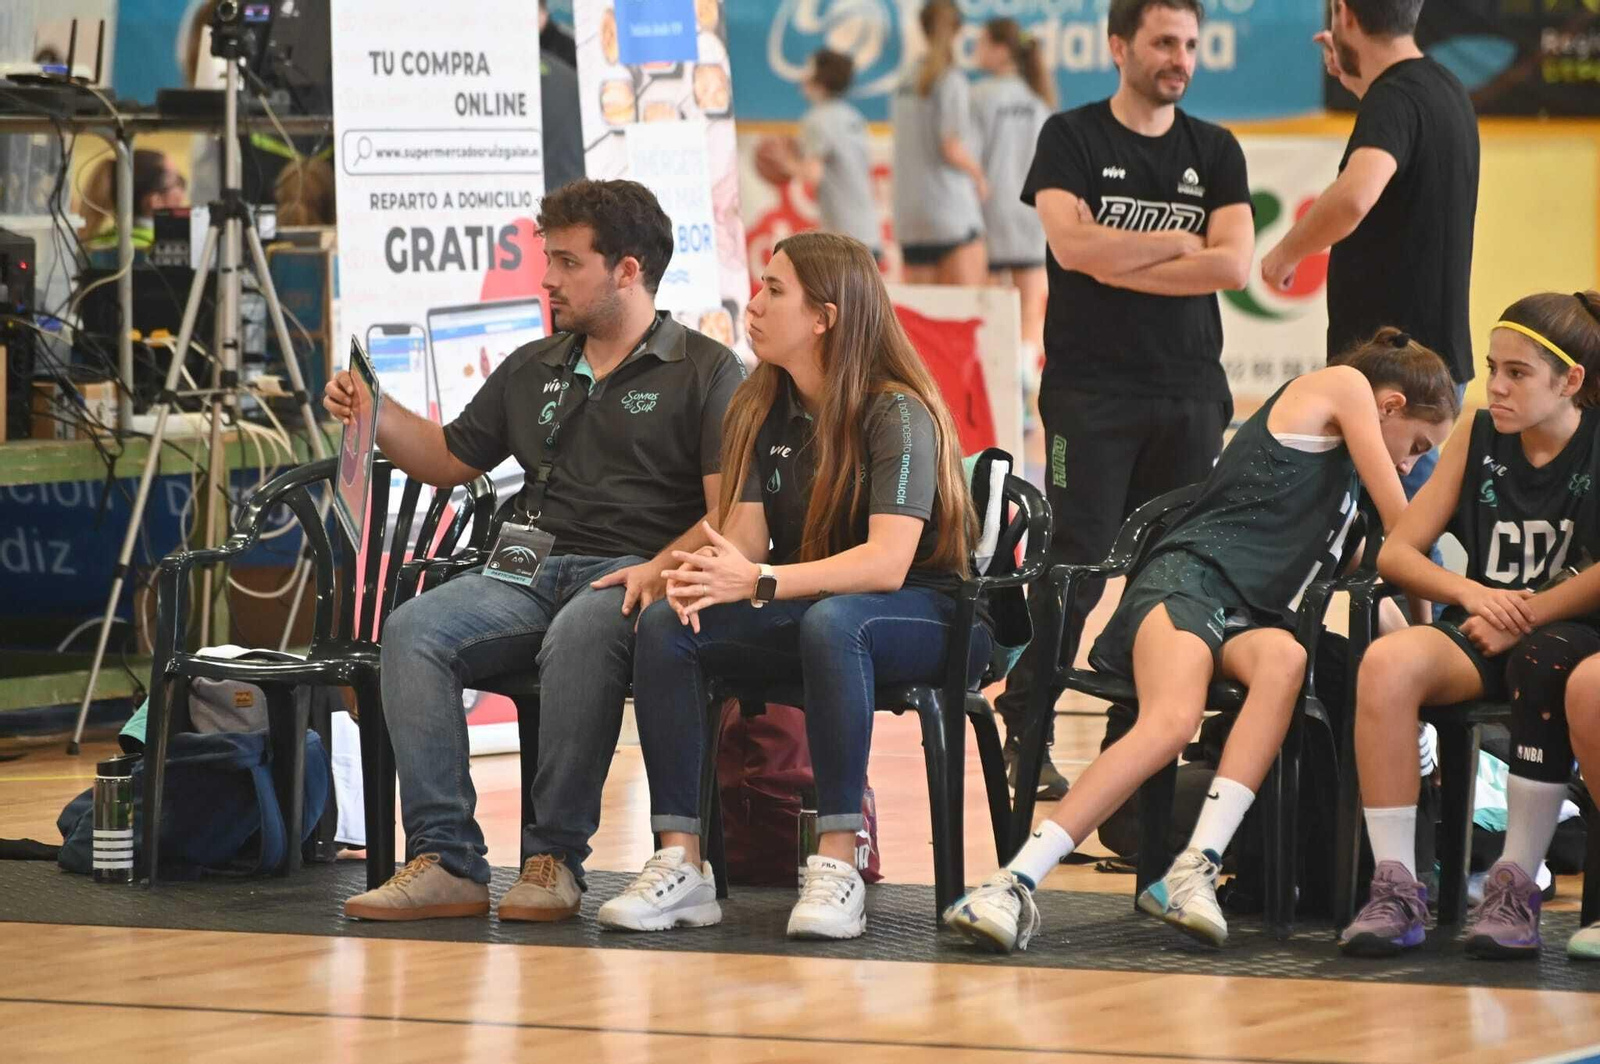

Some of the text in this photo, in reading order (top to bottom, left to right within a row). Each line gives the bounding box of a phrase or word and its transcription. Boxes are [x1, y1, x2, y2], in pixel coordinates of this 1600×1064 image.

[369, 51, 490, 76] TU COMPRA
[455, 92, 526, 116] ONLINE
[370, 191, 532, 210] REPARTO A DOMICILIO
[385, 224, 522, 273] GRATIS
[676, 223, 712, 253] BOR
[1523, 746, 1544, 764] NBA
